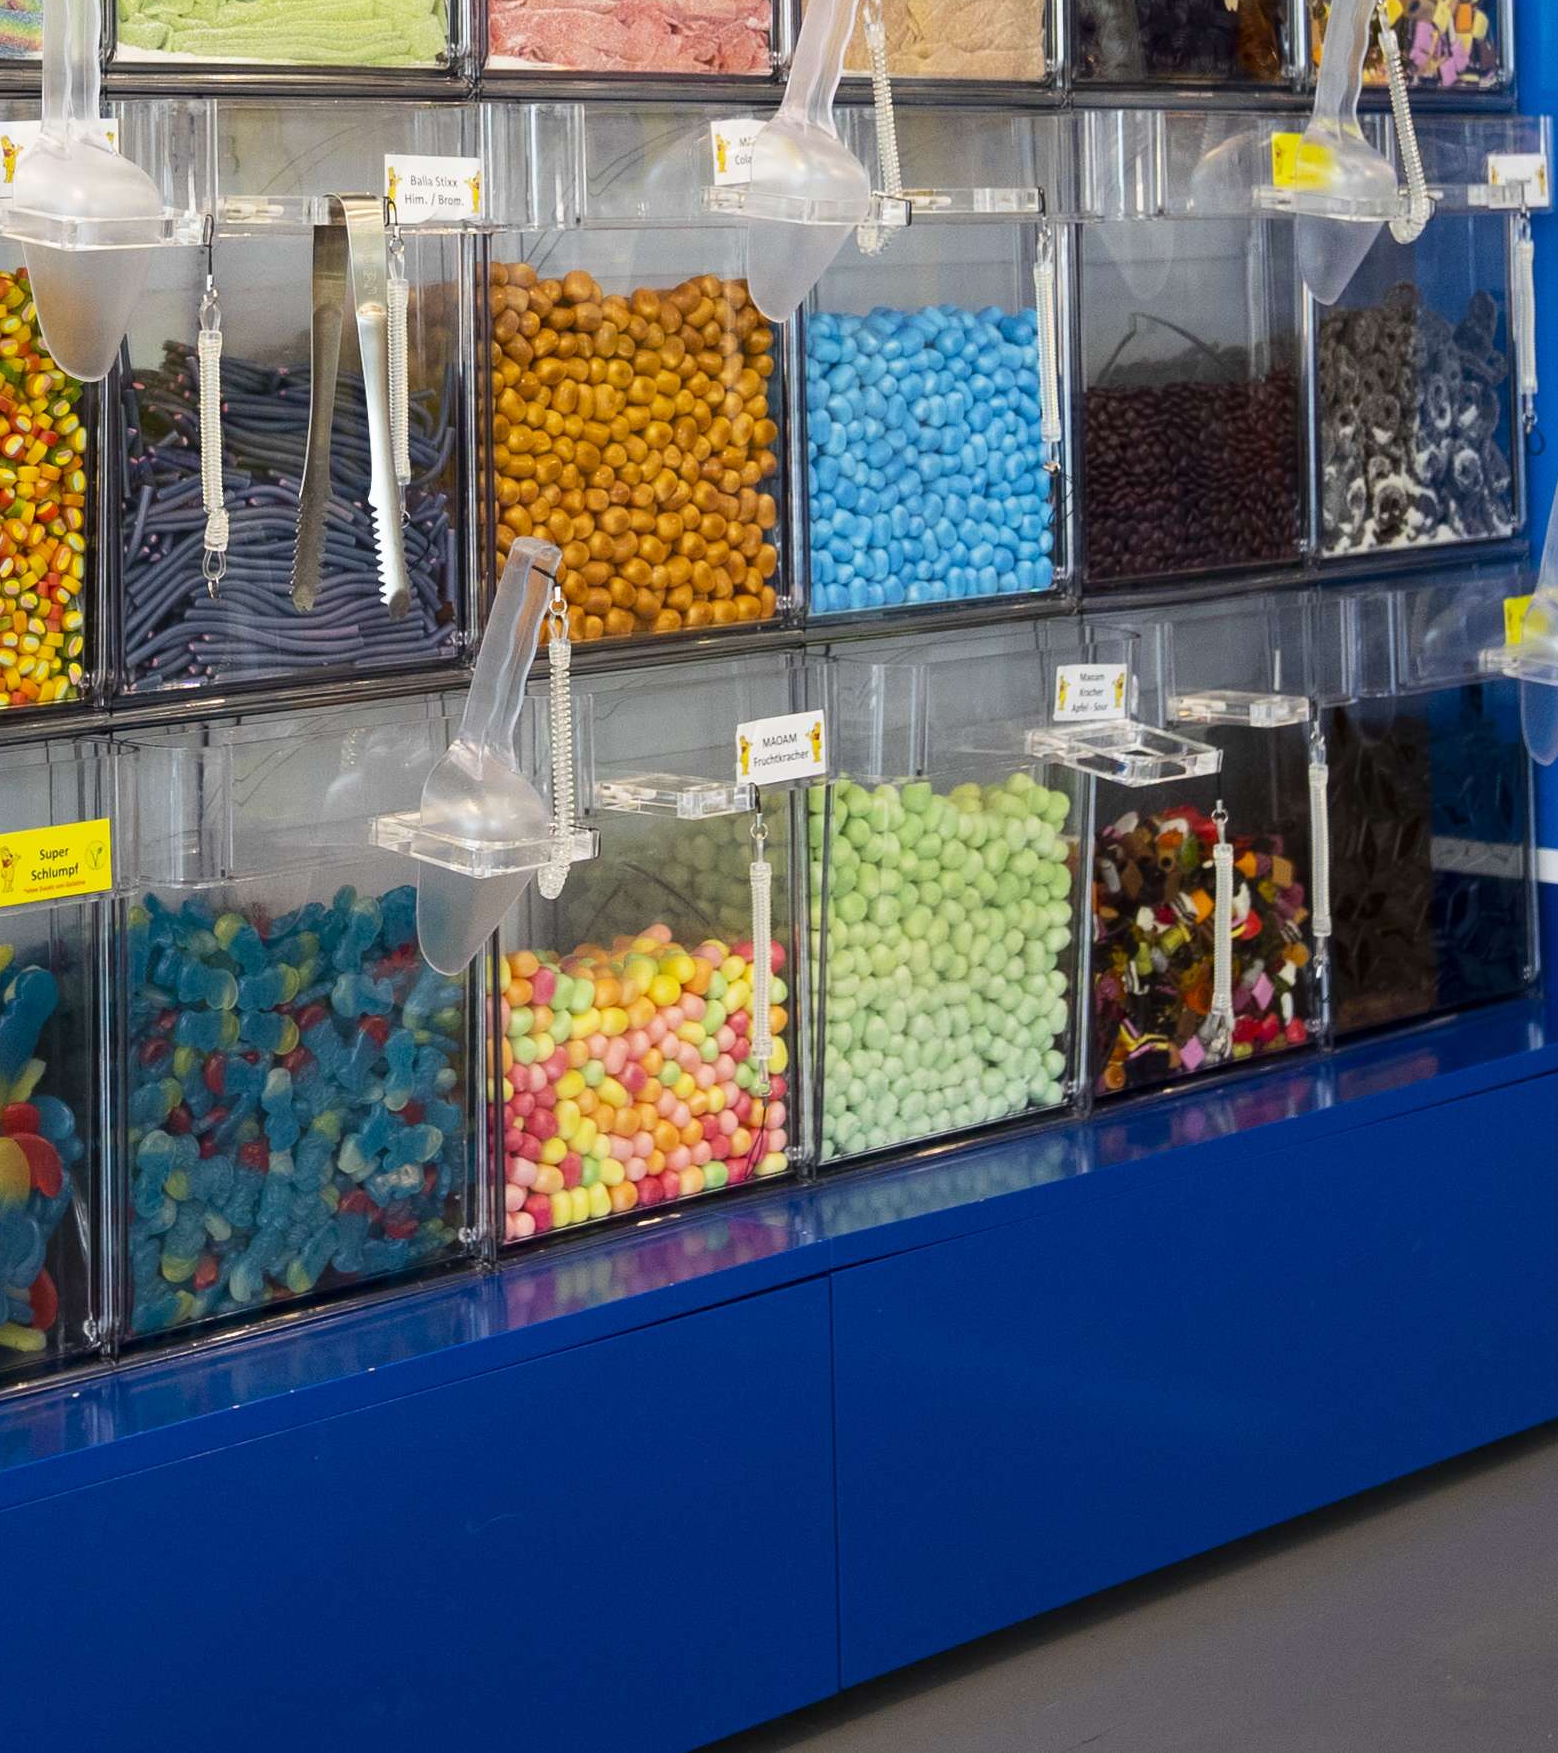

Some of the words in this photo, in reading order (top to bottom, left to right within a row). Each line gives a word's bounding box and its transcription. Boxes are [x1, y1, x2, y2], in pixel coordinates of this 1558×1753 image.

[410, 175, 434, 187] Balla
[438, 194, 465, 206] Brom.
[762, 733, 798, 748] MAOAM
[753, 750, 809, 767] Fruchtkracher
[39, 847, 69, 861] Super
[31, 863, 79, 882] Schlumpf
